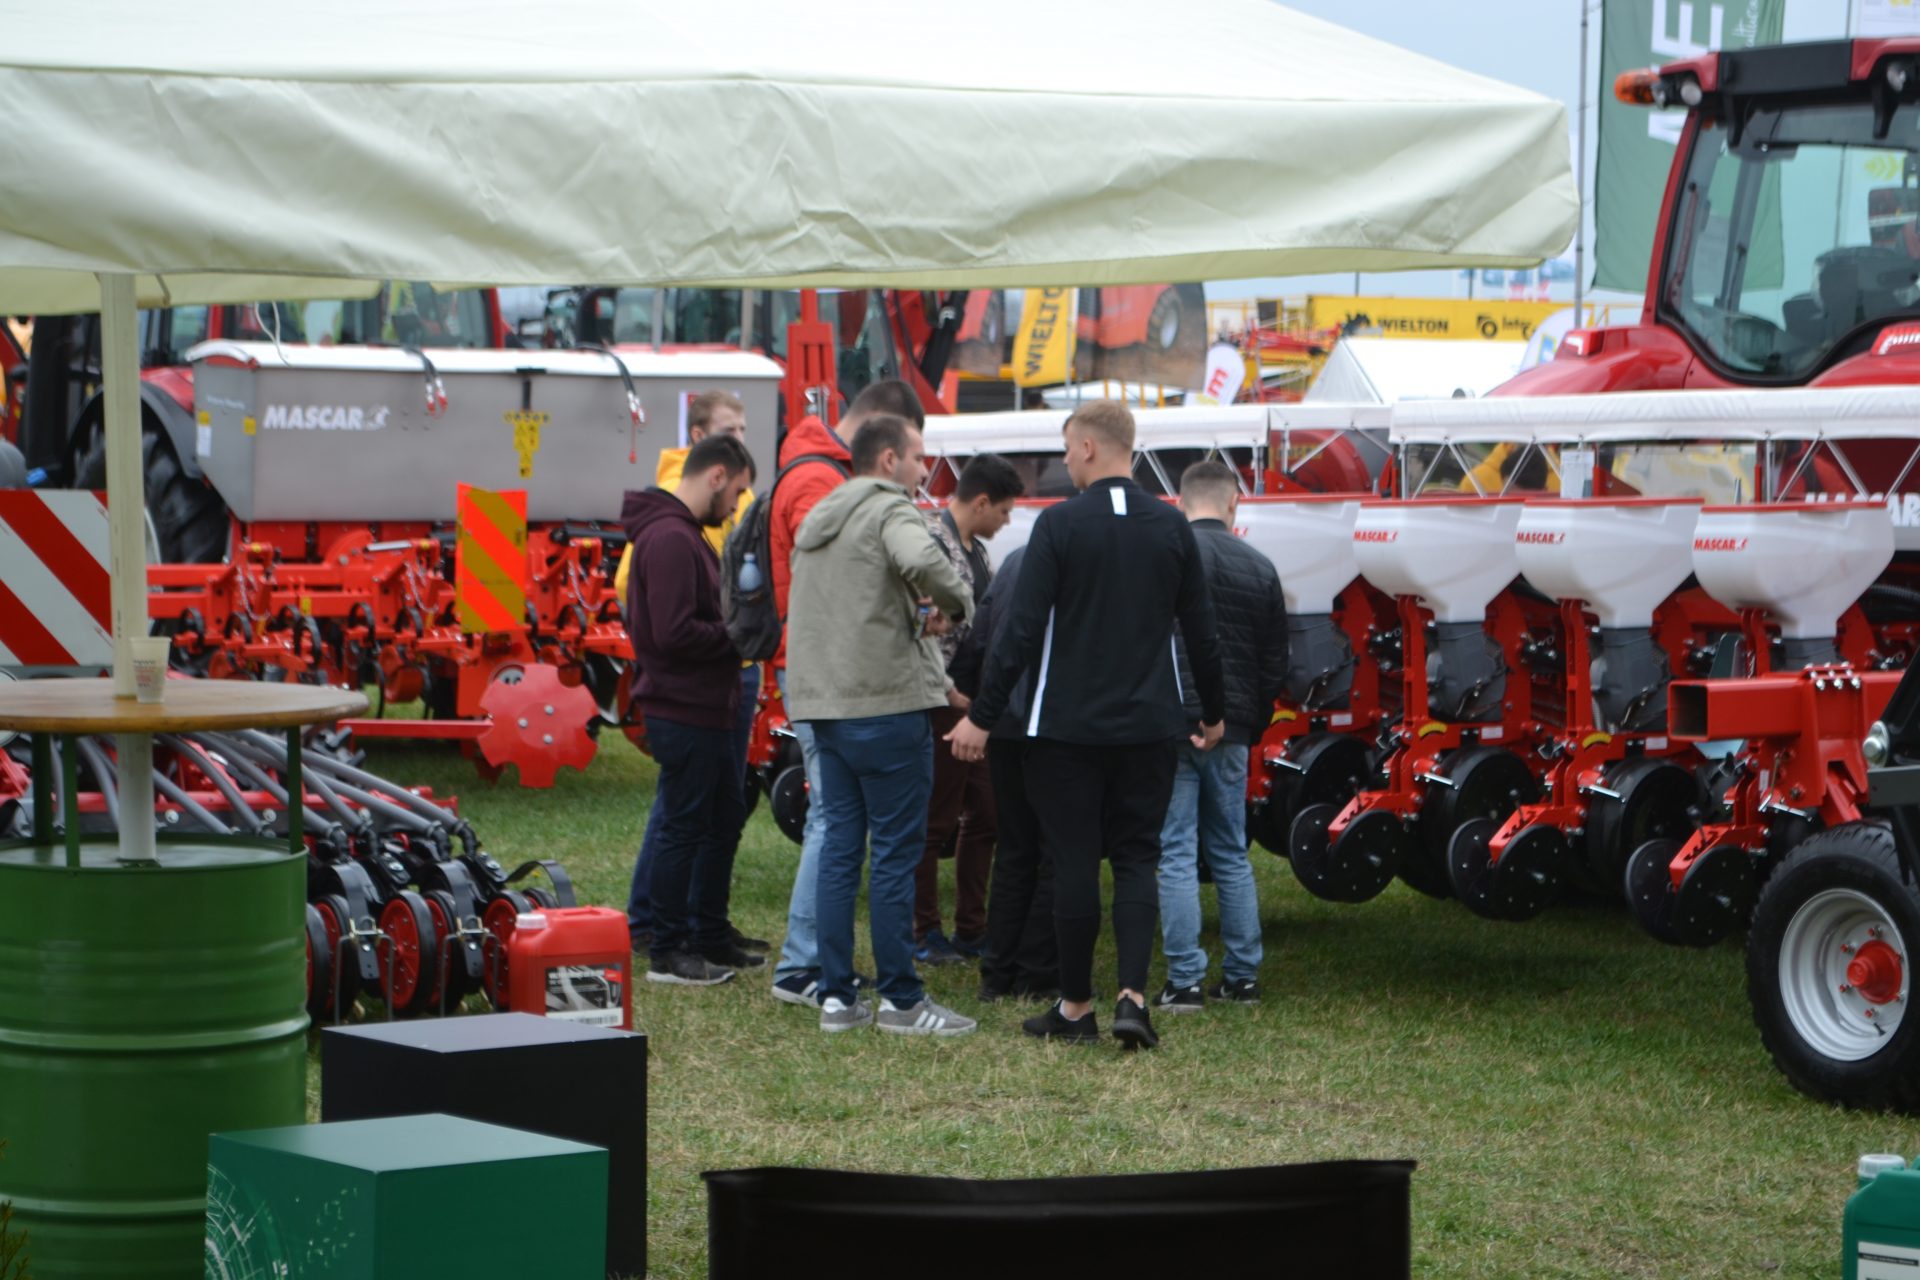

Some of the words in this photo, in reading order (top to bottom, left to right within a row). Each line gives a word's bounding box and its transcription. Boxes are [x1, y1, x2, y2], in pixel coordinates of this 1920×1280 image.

[1377, 317, 1449, 333] WIELTON
[263, 404, 364, 431] MASCAR
[1353, 530, 1388, 543] MASCAR
[1516, 532, 1554, 544] MASCAR
[1693, 538, 1735, 551] MASCAR
